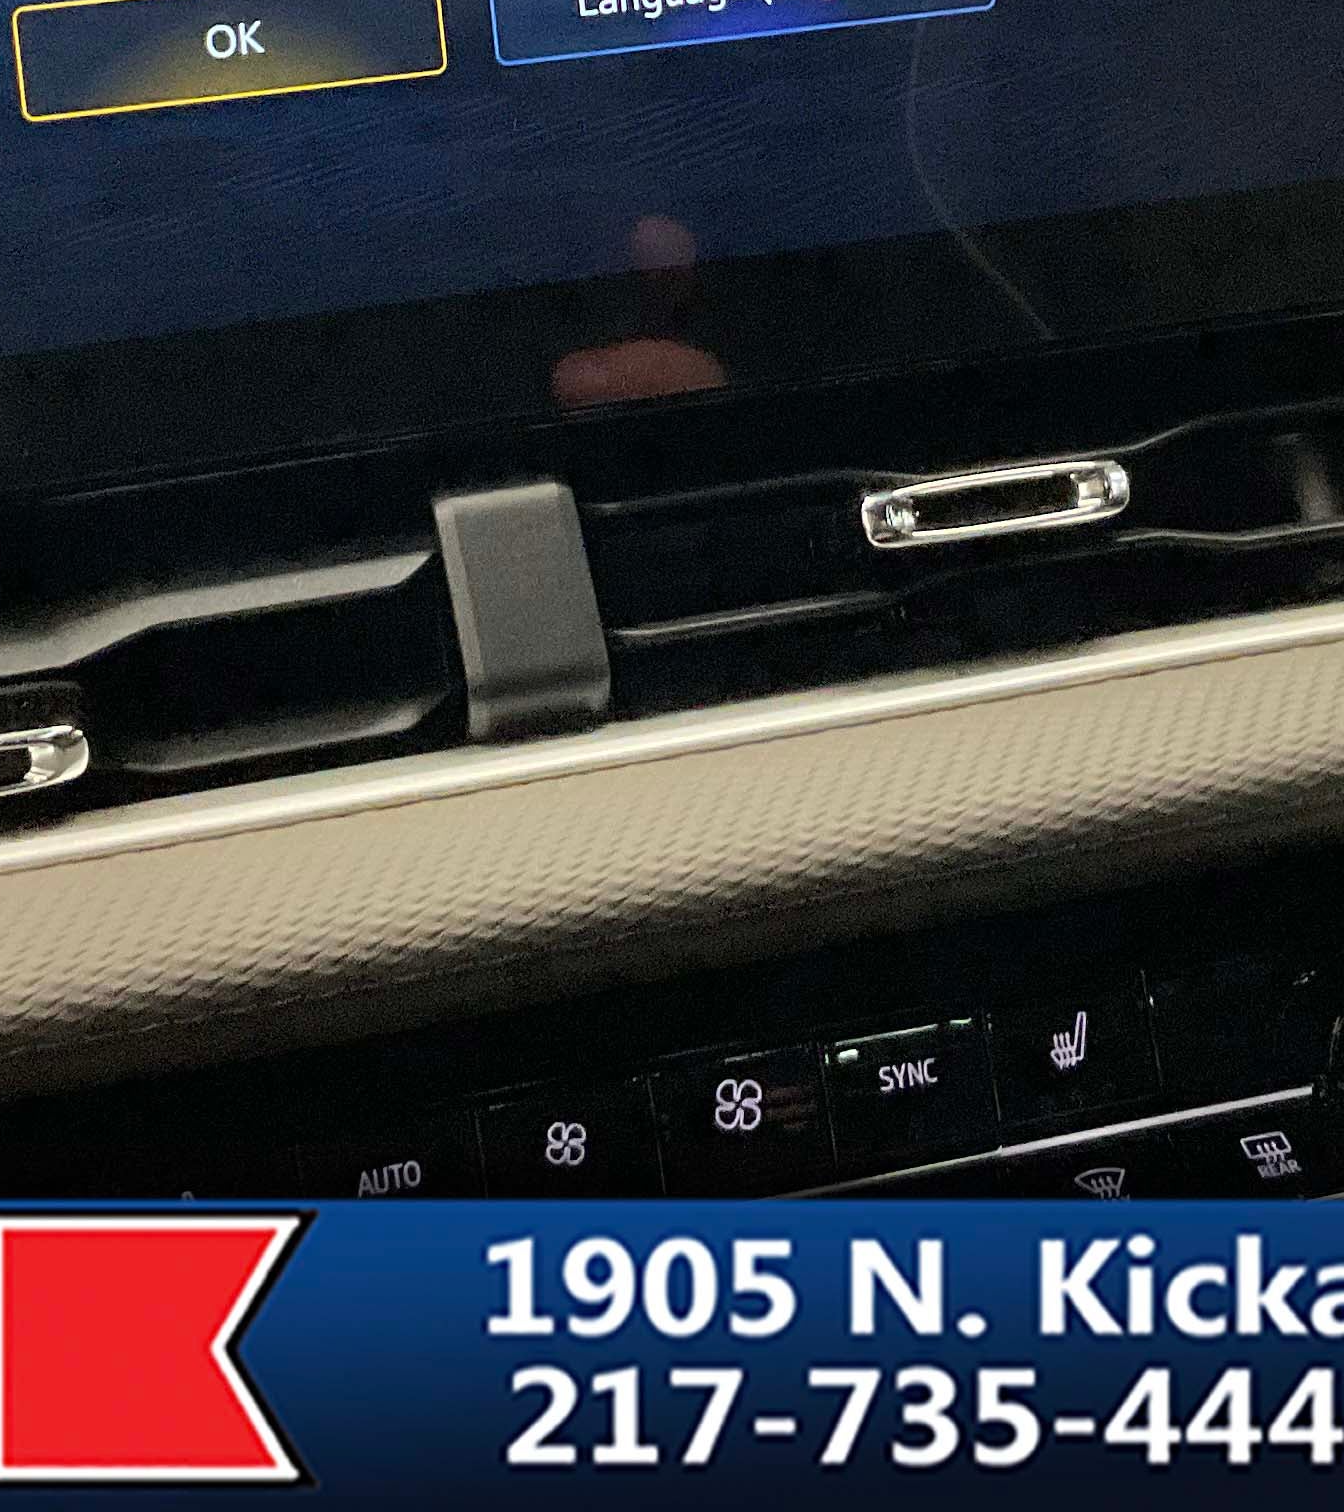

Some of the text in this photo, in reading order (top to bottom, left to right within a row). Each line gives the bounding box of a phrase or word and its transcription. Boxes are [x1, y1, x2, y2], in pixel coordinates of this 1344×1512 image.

[204, 19, 266, 61] OK
[878, 1056, 939, 1093] SYNC
[357, 1159, 423, 1199] AUTO
[1256, 1158, 1303, 1178] REAR
